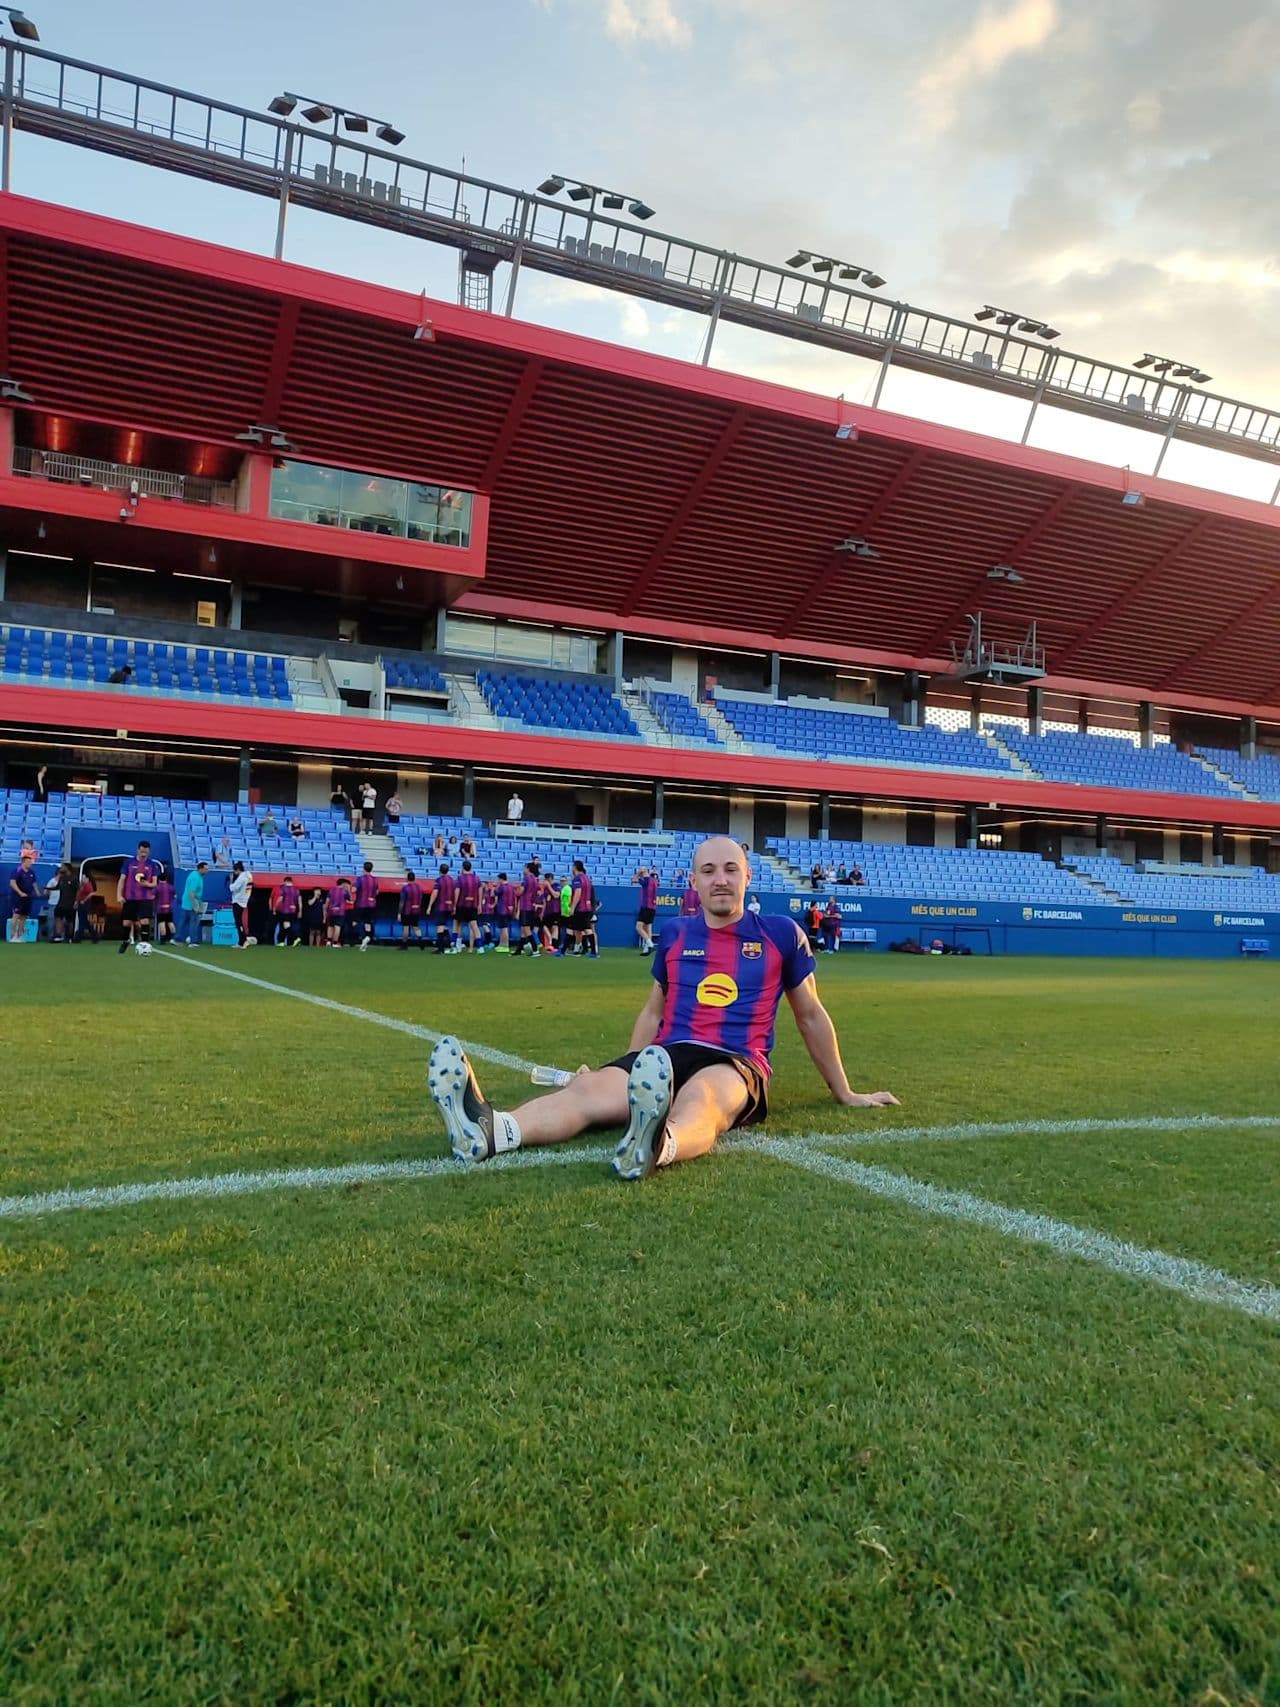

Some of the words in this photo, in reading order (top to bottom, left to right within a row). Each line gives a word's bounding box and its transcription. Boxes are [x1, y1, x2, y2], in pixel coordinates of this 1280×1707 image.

[929, 906, 944, 916] QUE
[946, 907, 956, 916] UN
[1034, 910, 1042, 919] FC
[1043, 910, 1082, 920] BARCELONA
[1223, 917, 1231, 925] FC
